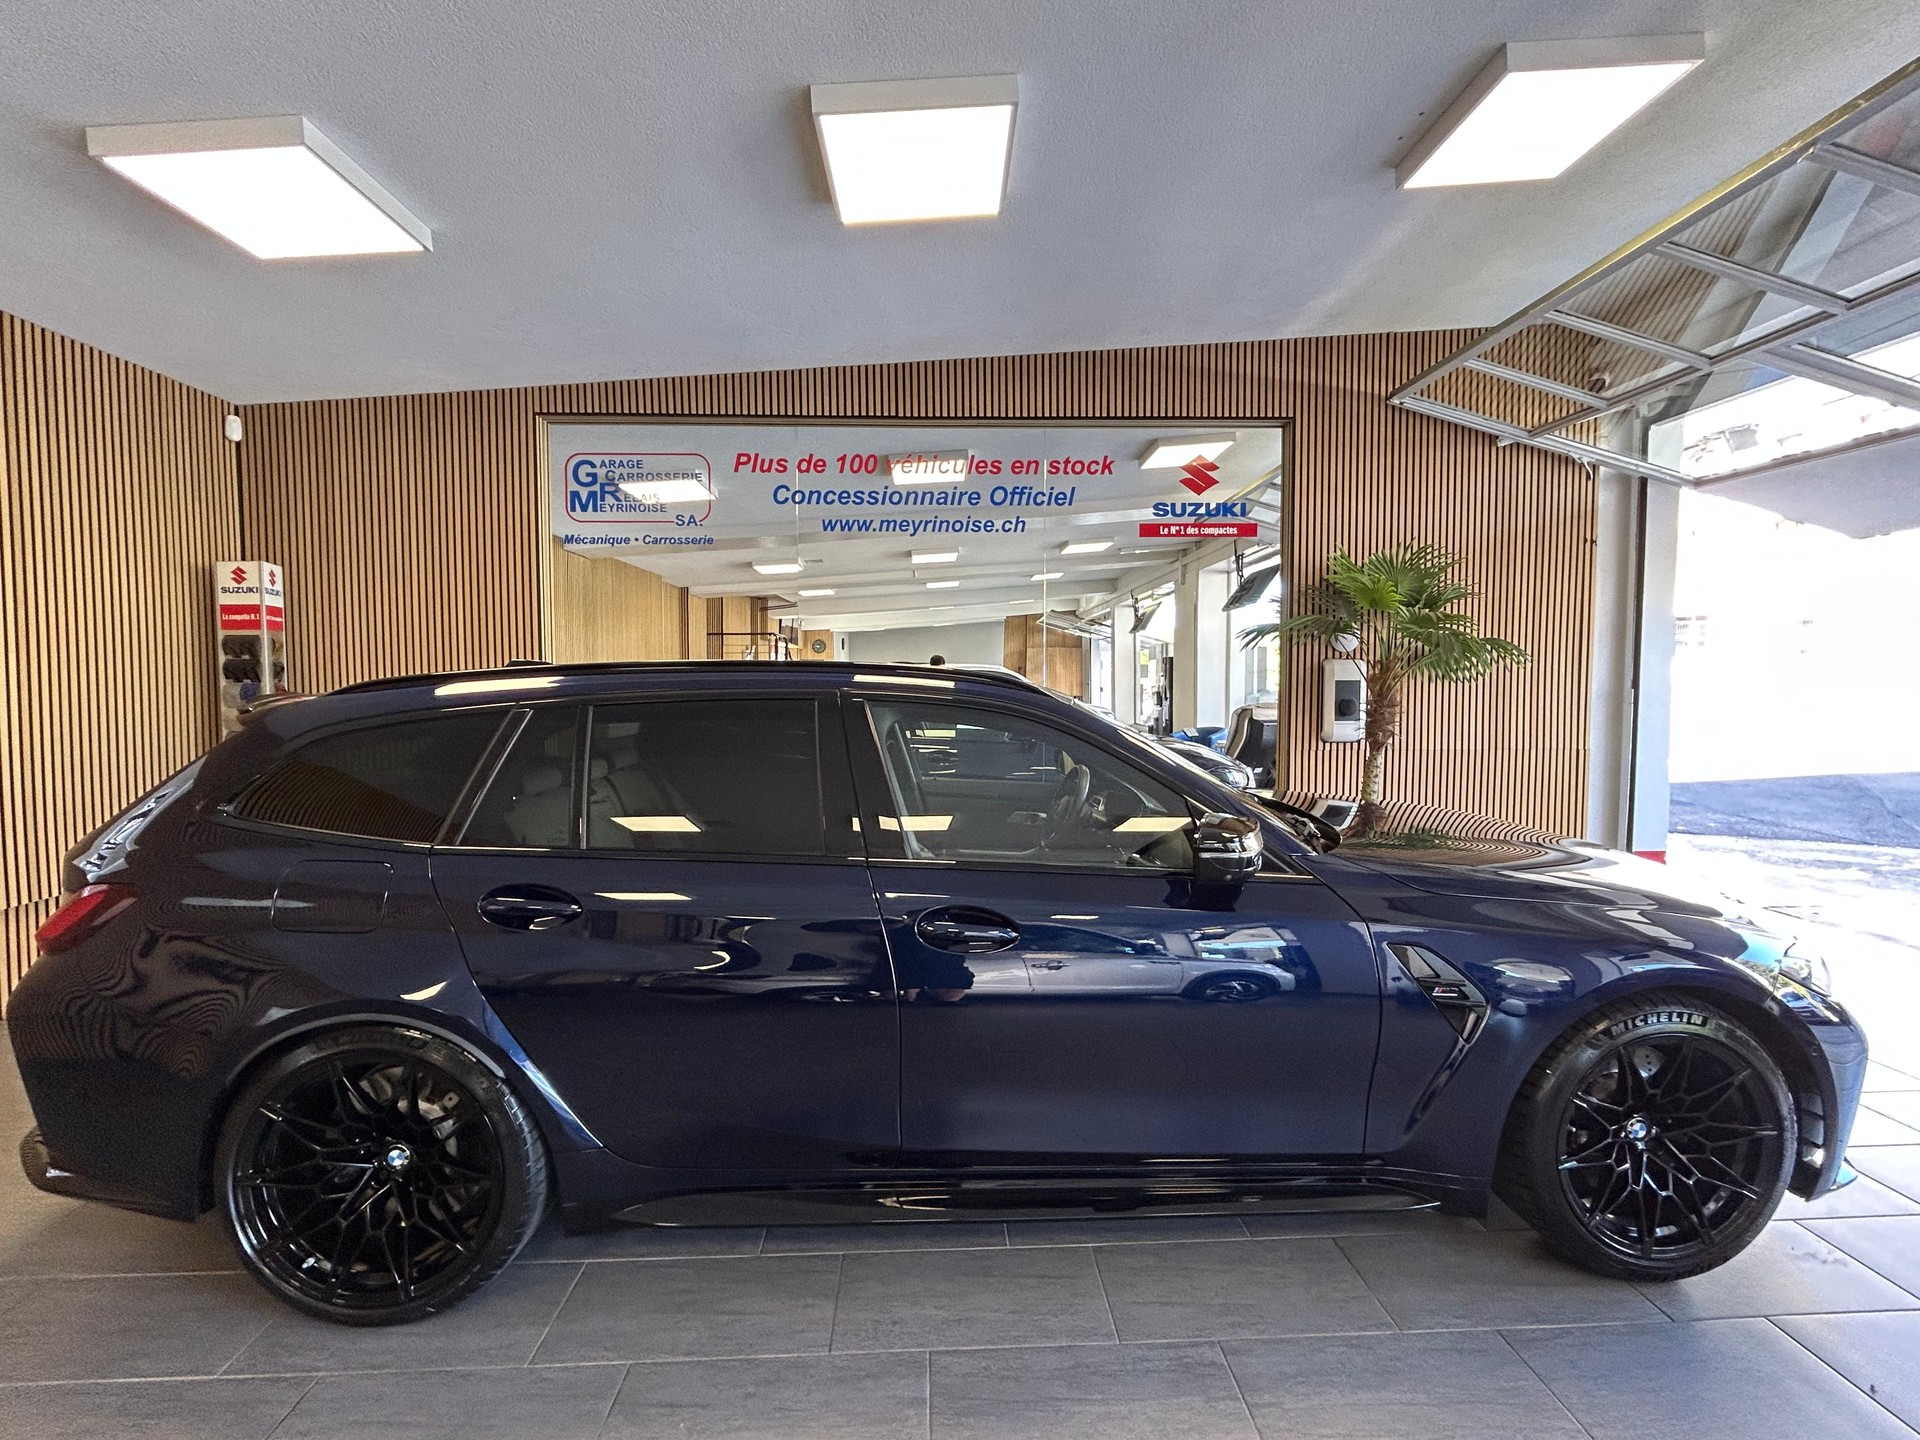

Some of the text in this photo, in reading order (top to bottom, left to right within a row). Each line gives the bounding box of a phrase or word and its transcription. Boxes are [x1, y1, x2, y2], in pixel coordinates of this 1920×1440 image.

[733, 452, 1115, 475] Plus de 100 véhicules en stock
[772, 484, 1076, 507] Concessionnaire Officiel
[1152, 501, 1247, 518] SUZUKI
[821, 515, 1026, 537] www.meyrinoise.ch
[1160, 525, 1169, 535] Le
[1186, 525, 1199, 535] des
[1200, 526, 1238, 536] compactes
[563, 534, 714, 547] Mécanique Carrosserie
[220, 586, 259, 594] SUZUKI
[1610, 1012, 1703, 1036] MICHELIN
